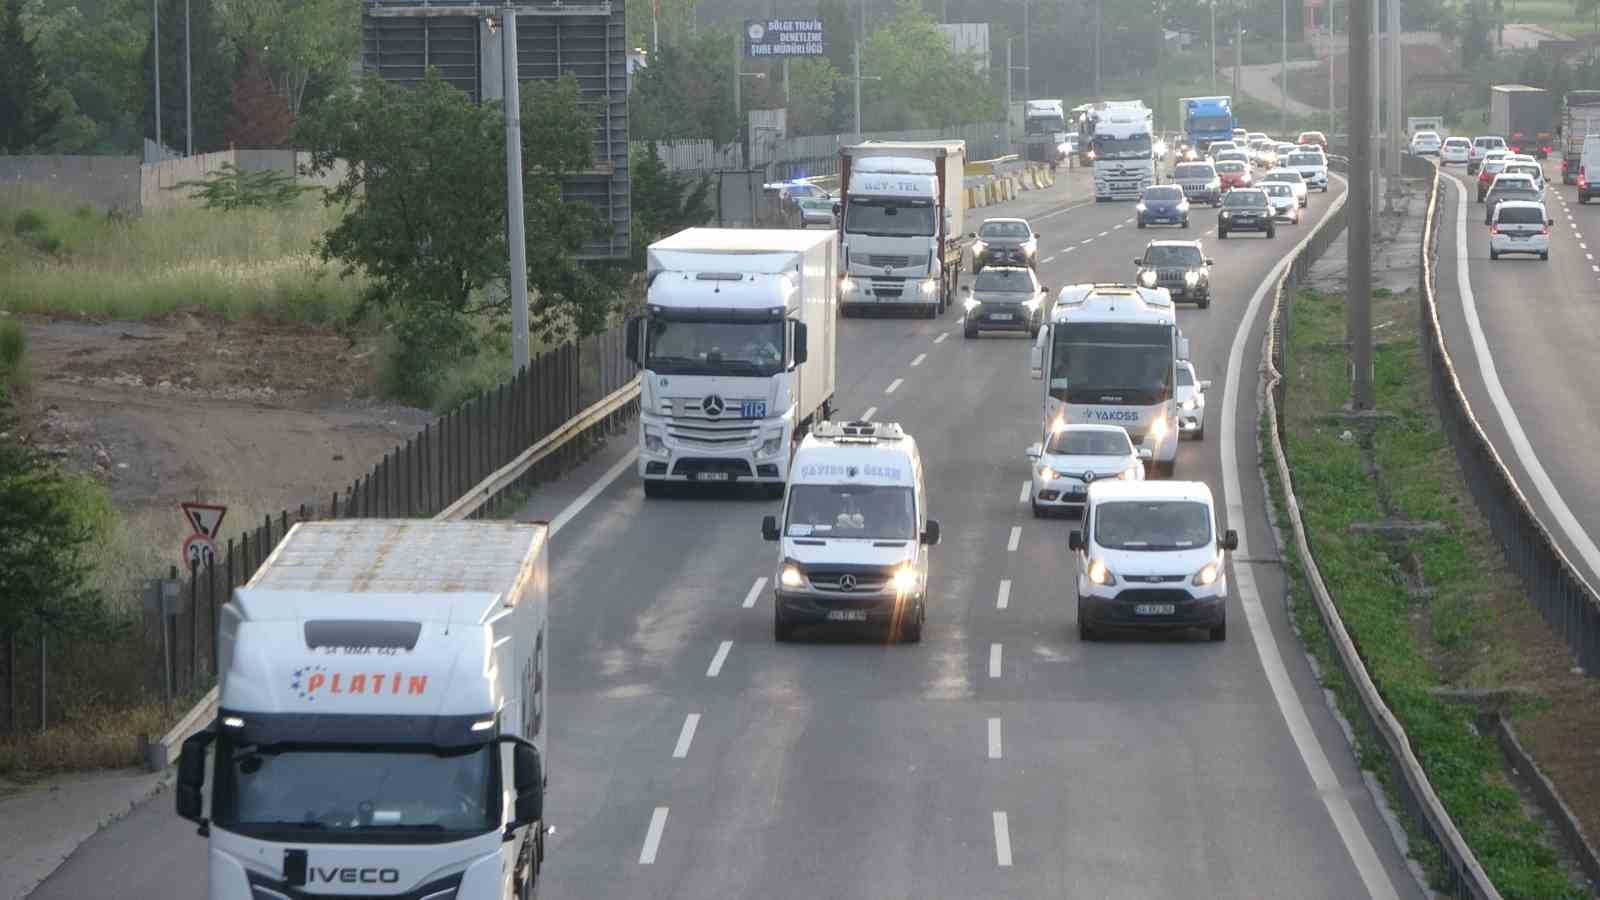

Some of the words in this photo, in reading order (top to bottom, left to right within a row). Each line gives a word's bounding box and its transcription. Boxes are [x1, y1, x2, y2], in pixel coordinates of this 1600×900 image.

[780, 32, 822, 42] DENETLEME
[743, 401, 765, 416] TIR
[1095, 410, 1139, 421] YAKOSS
[308, 672, 428, 696] PLATİN
[309, 867, 399, 883] IVECO
